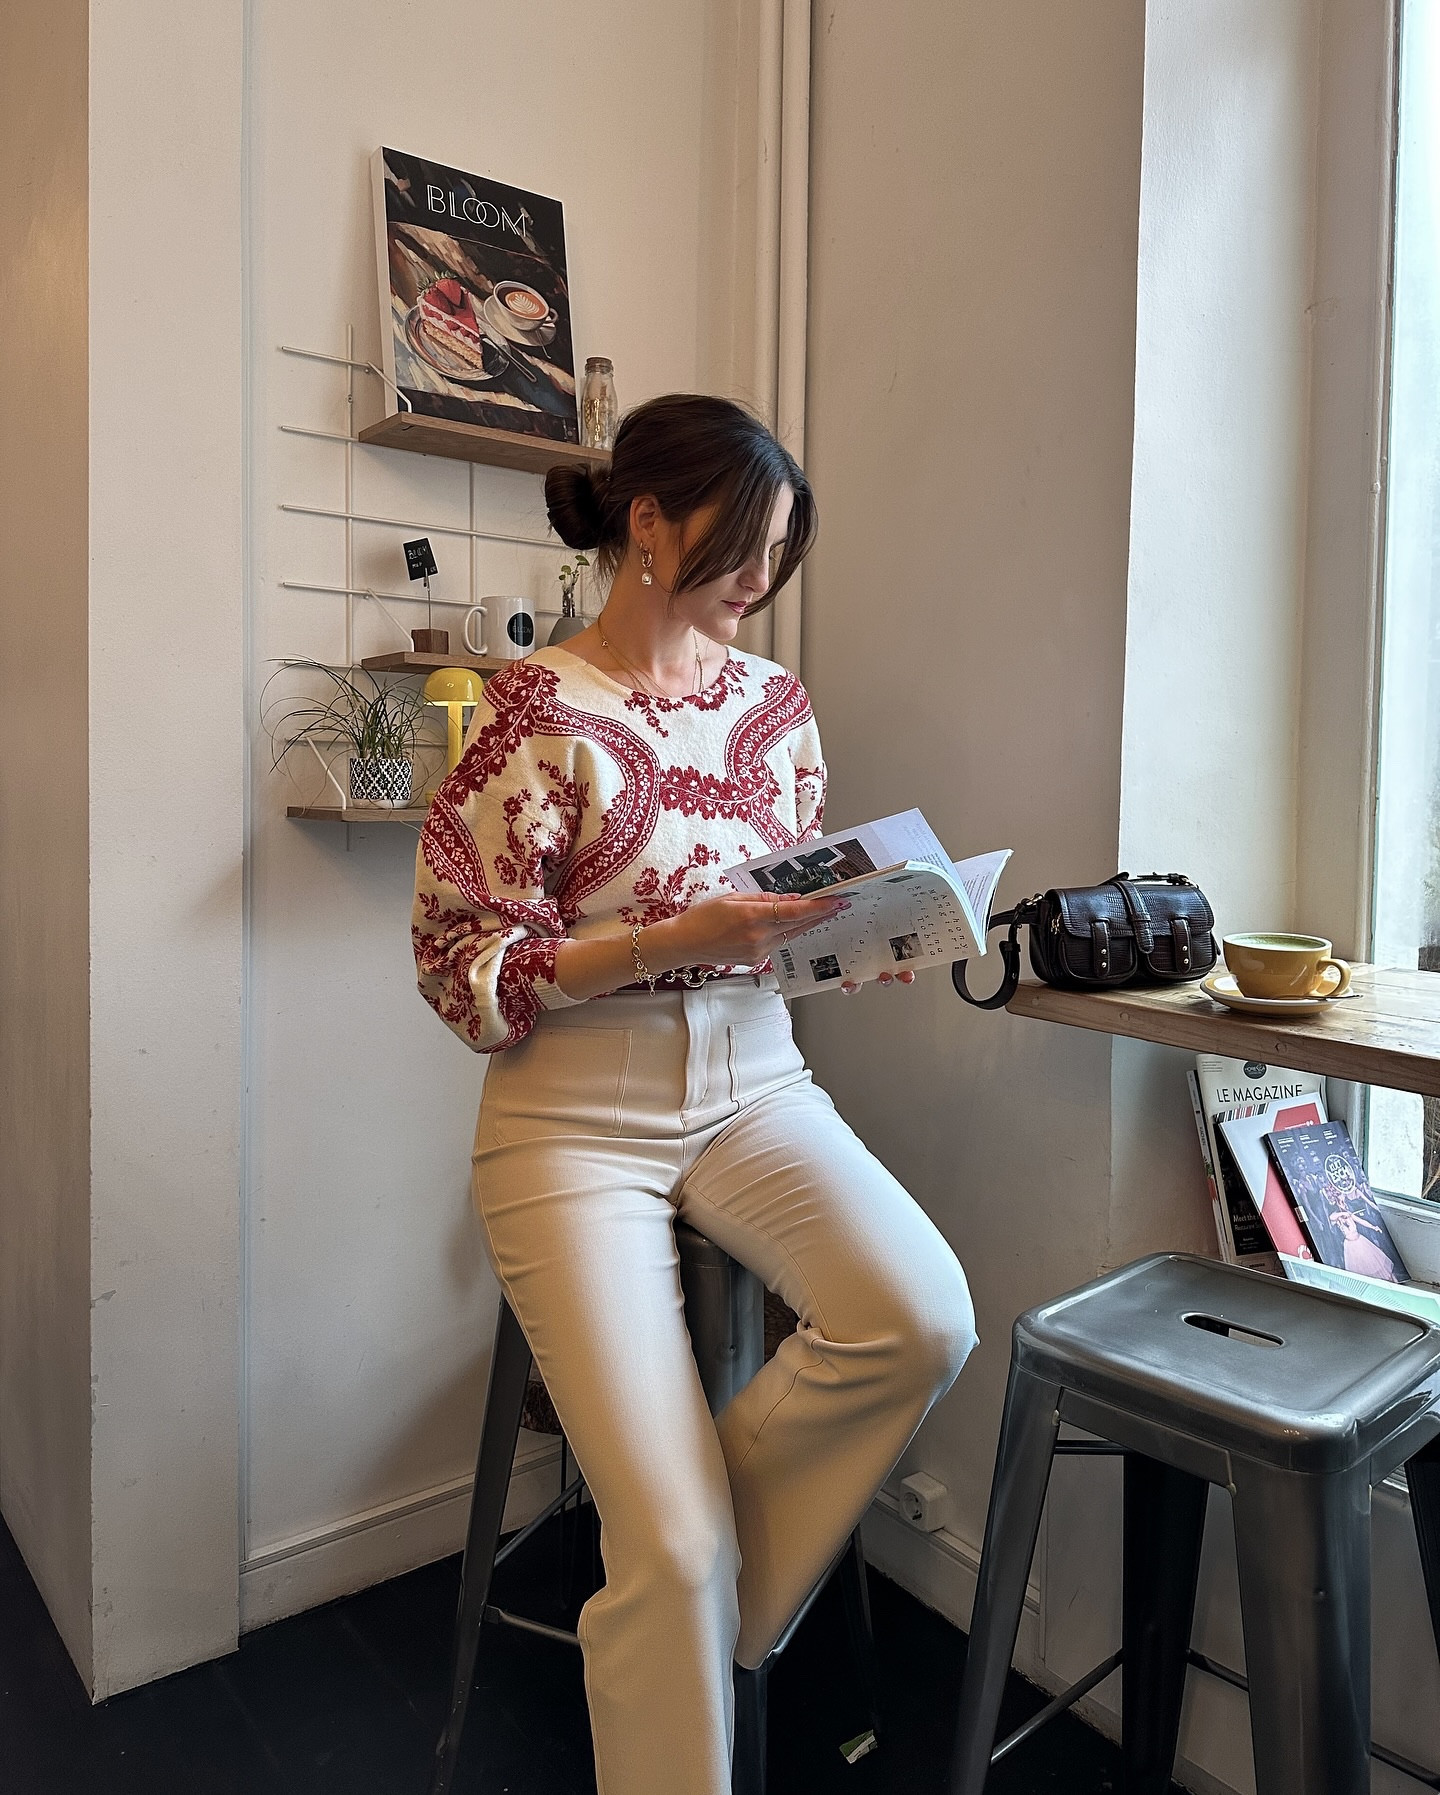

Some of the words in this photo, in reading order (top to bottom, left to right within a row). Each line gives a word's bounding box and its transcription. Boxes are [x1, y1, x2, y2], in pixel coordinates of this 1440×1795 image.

[426, 184, 527, 237] BLOOM
[1216, 1087, 1231, 1103] LE
[1233, 1084, 1303, 1102] MAGAZINE
